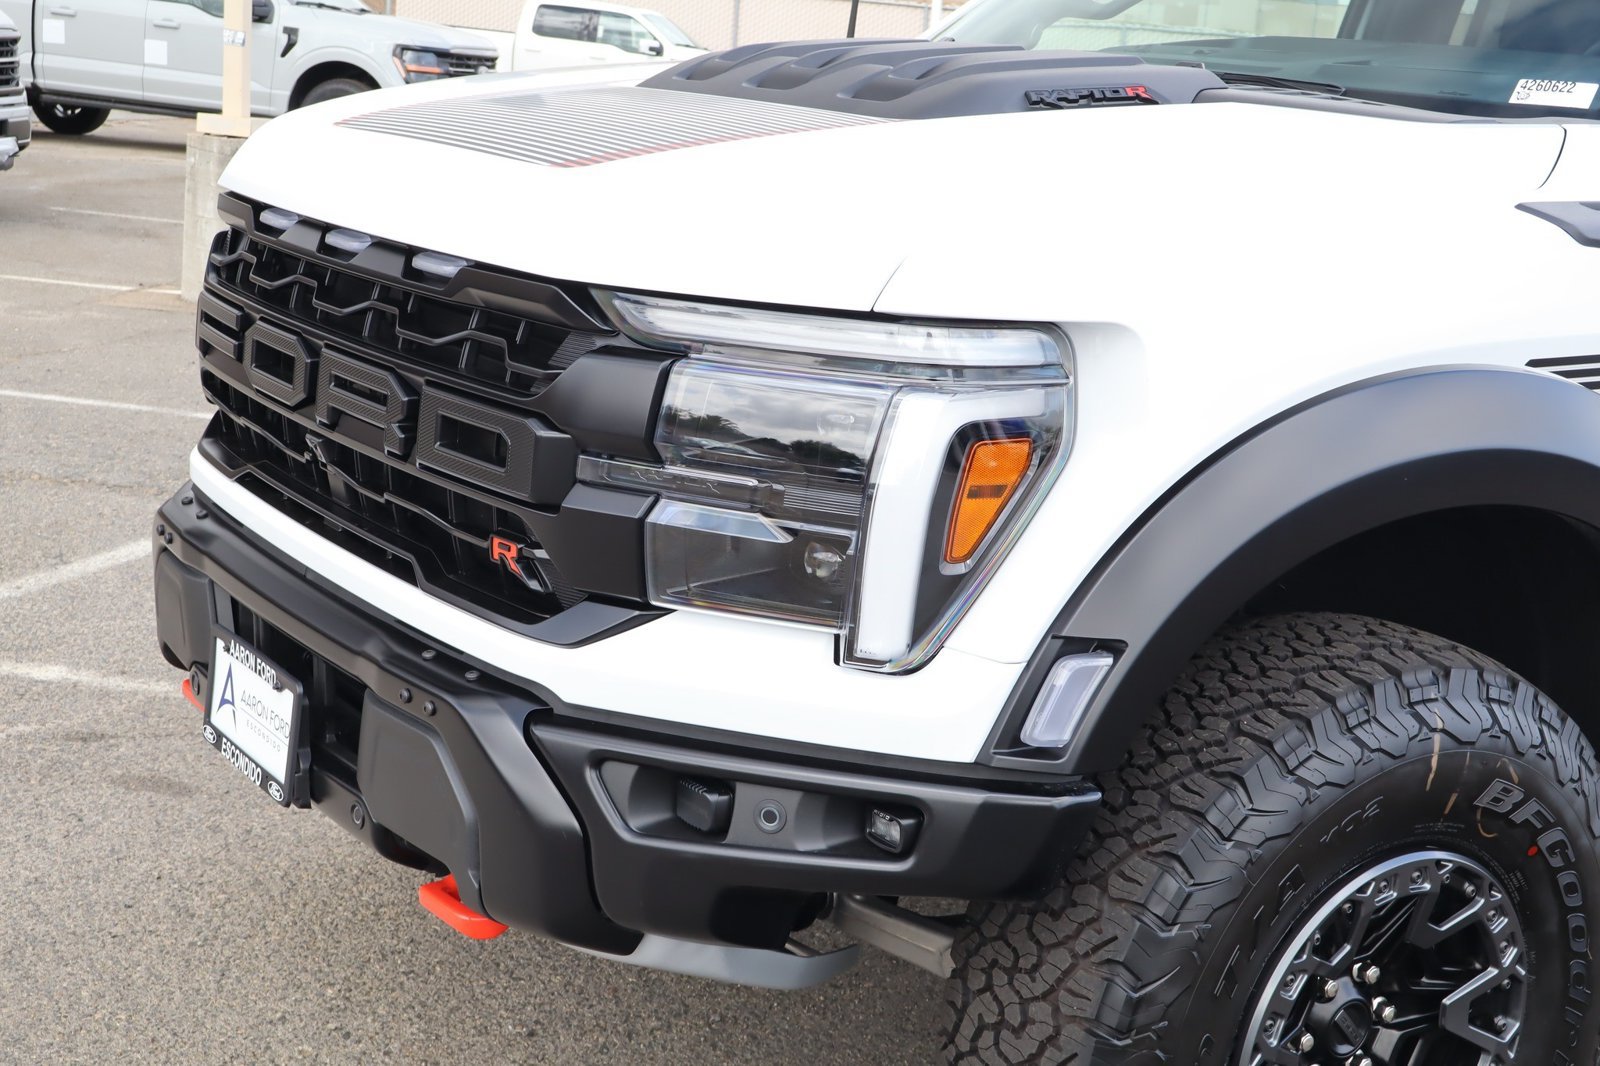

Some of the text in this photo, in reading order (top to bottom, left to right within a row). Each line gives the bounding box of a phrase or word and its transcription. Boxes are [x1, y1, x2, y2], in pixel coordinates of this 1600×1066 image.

[1024, 86, 1159, 109] RAPTOR
[1520, 80, 1576, 93] 4260622
[196, 289, 556, 502] FORD
[489, 534, 529, 588] R
[229, 639, 277, 687] AARON FORD
[240, 690, 290, 739] AARON FORD
[246, 719, 281, 752] ESCONDIDO
[221, 738, 262, 786] ESCONDIDO
